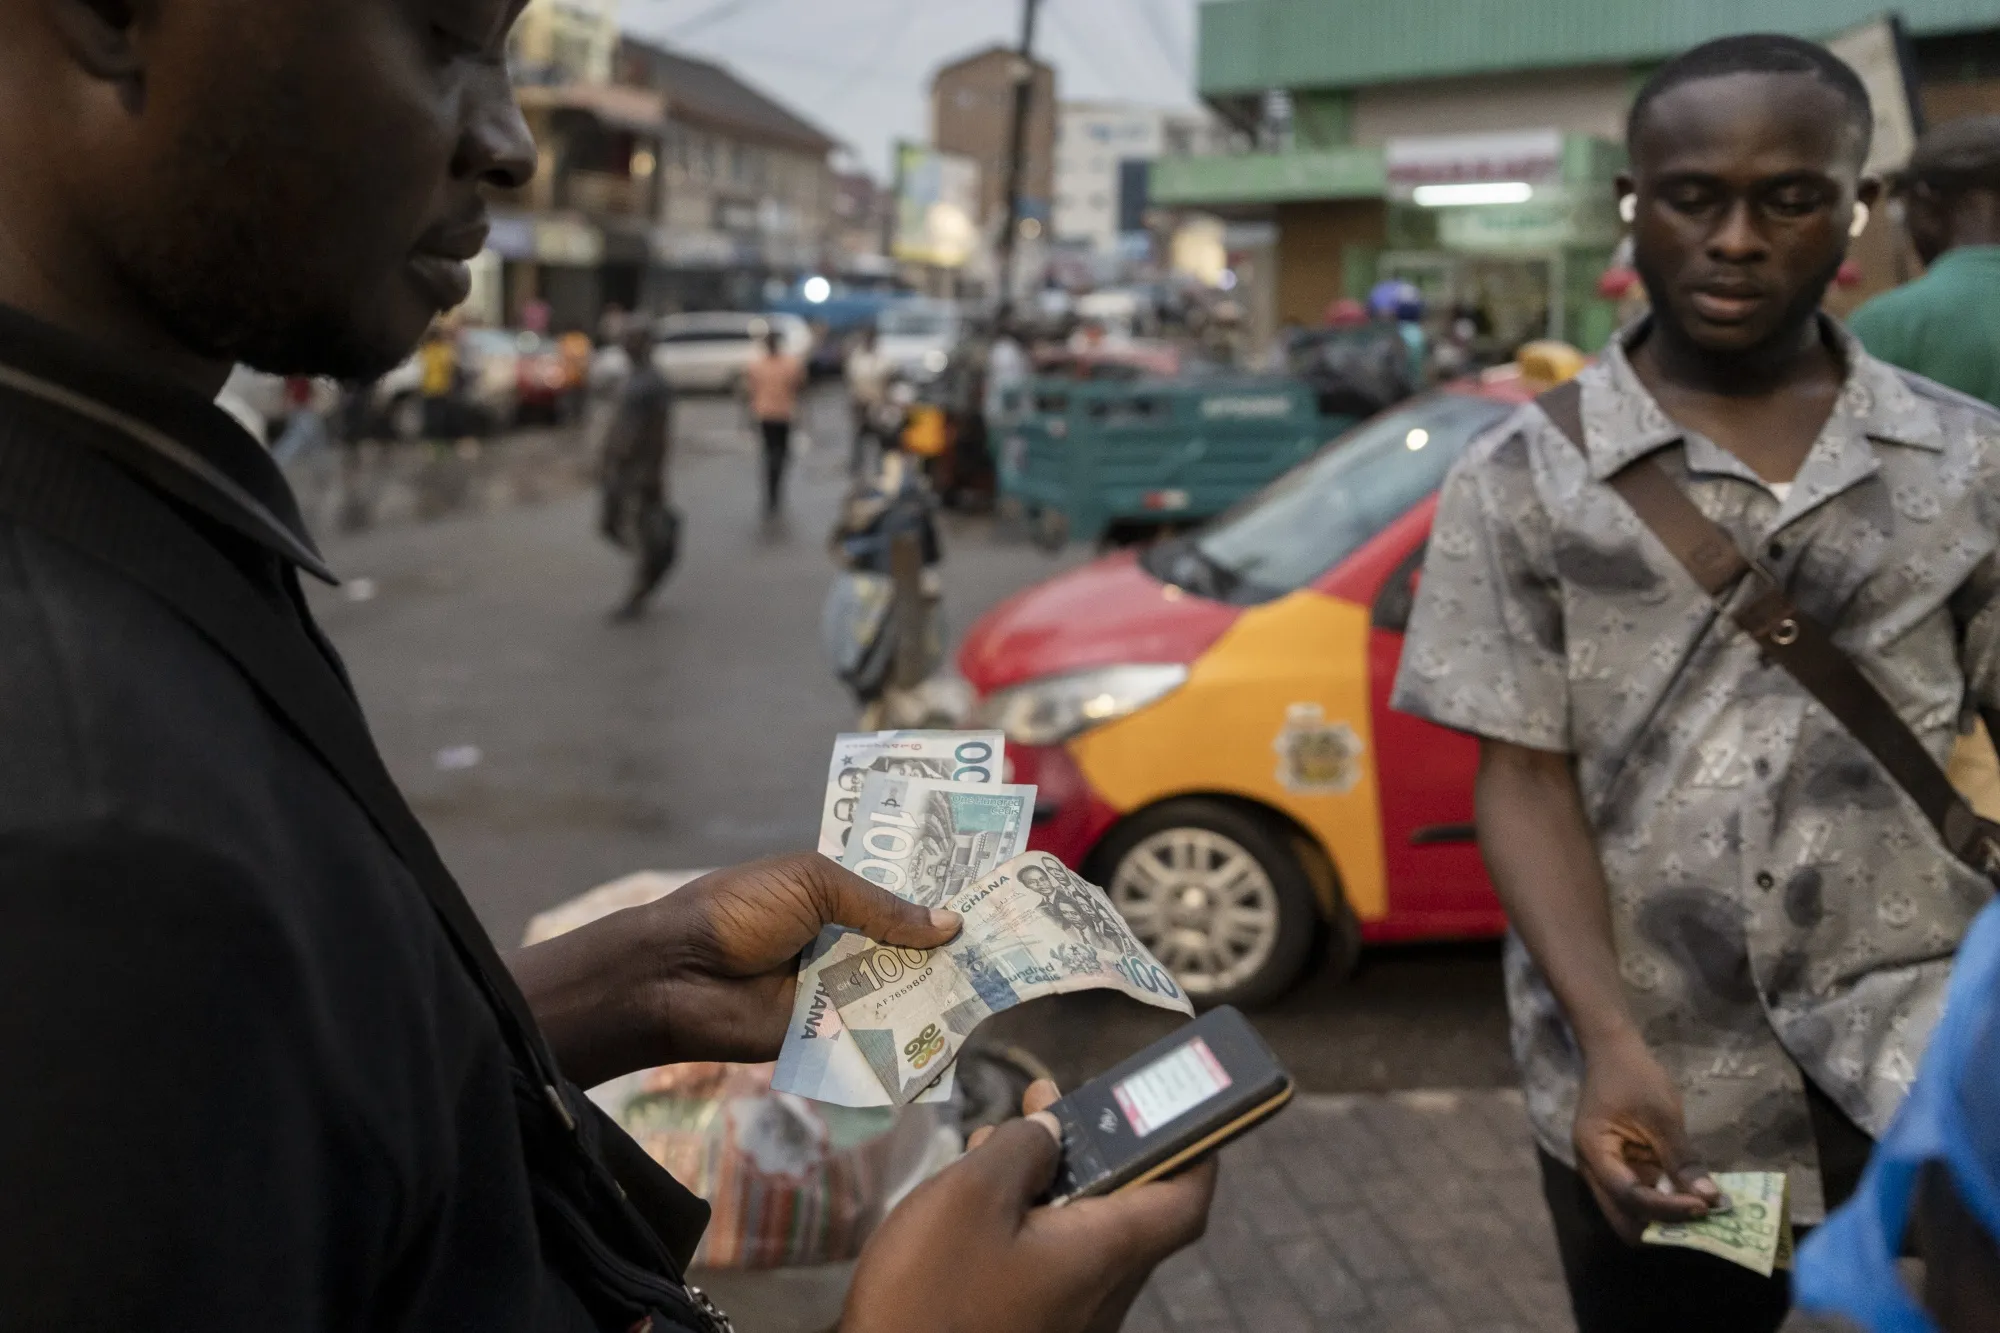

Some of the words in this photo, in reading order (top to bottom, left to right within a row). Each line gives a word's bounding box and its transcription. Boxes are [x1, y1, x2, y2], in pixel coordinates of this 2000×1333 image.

[952, 741, 992, 783] 00
[976, 796, 1021, 807] Hundred
[991, 807, 1019, 815] Cedis
[961, 874, 1010, 913] GHANA
[1025, 969, 1061, 985] Cedis
[800, 980, 829, 1040] HANA
